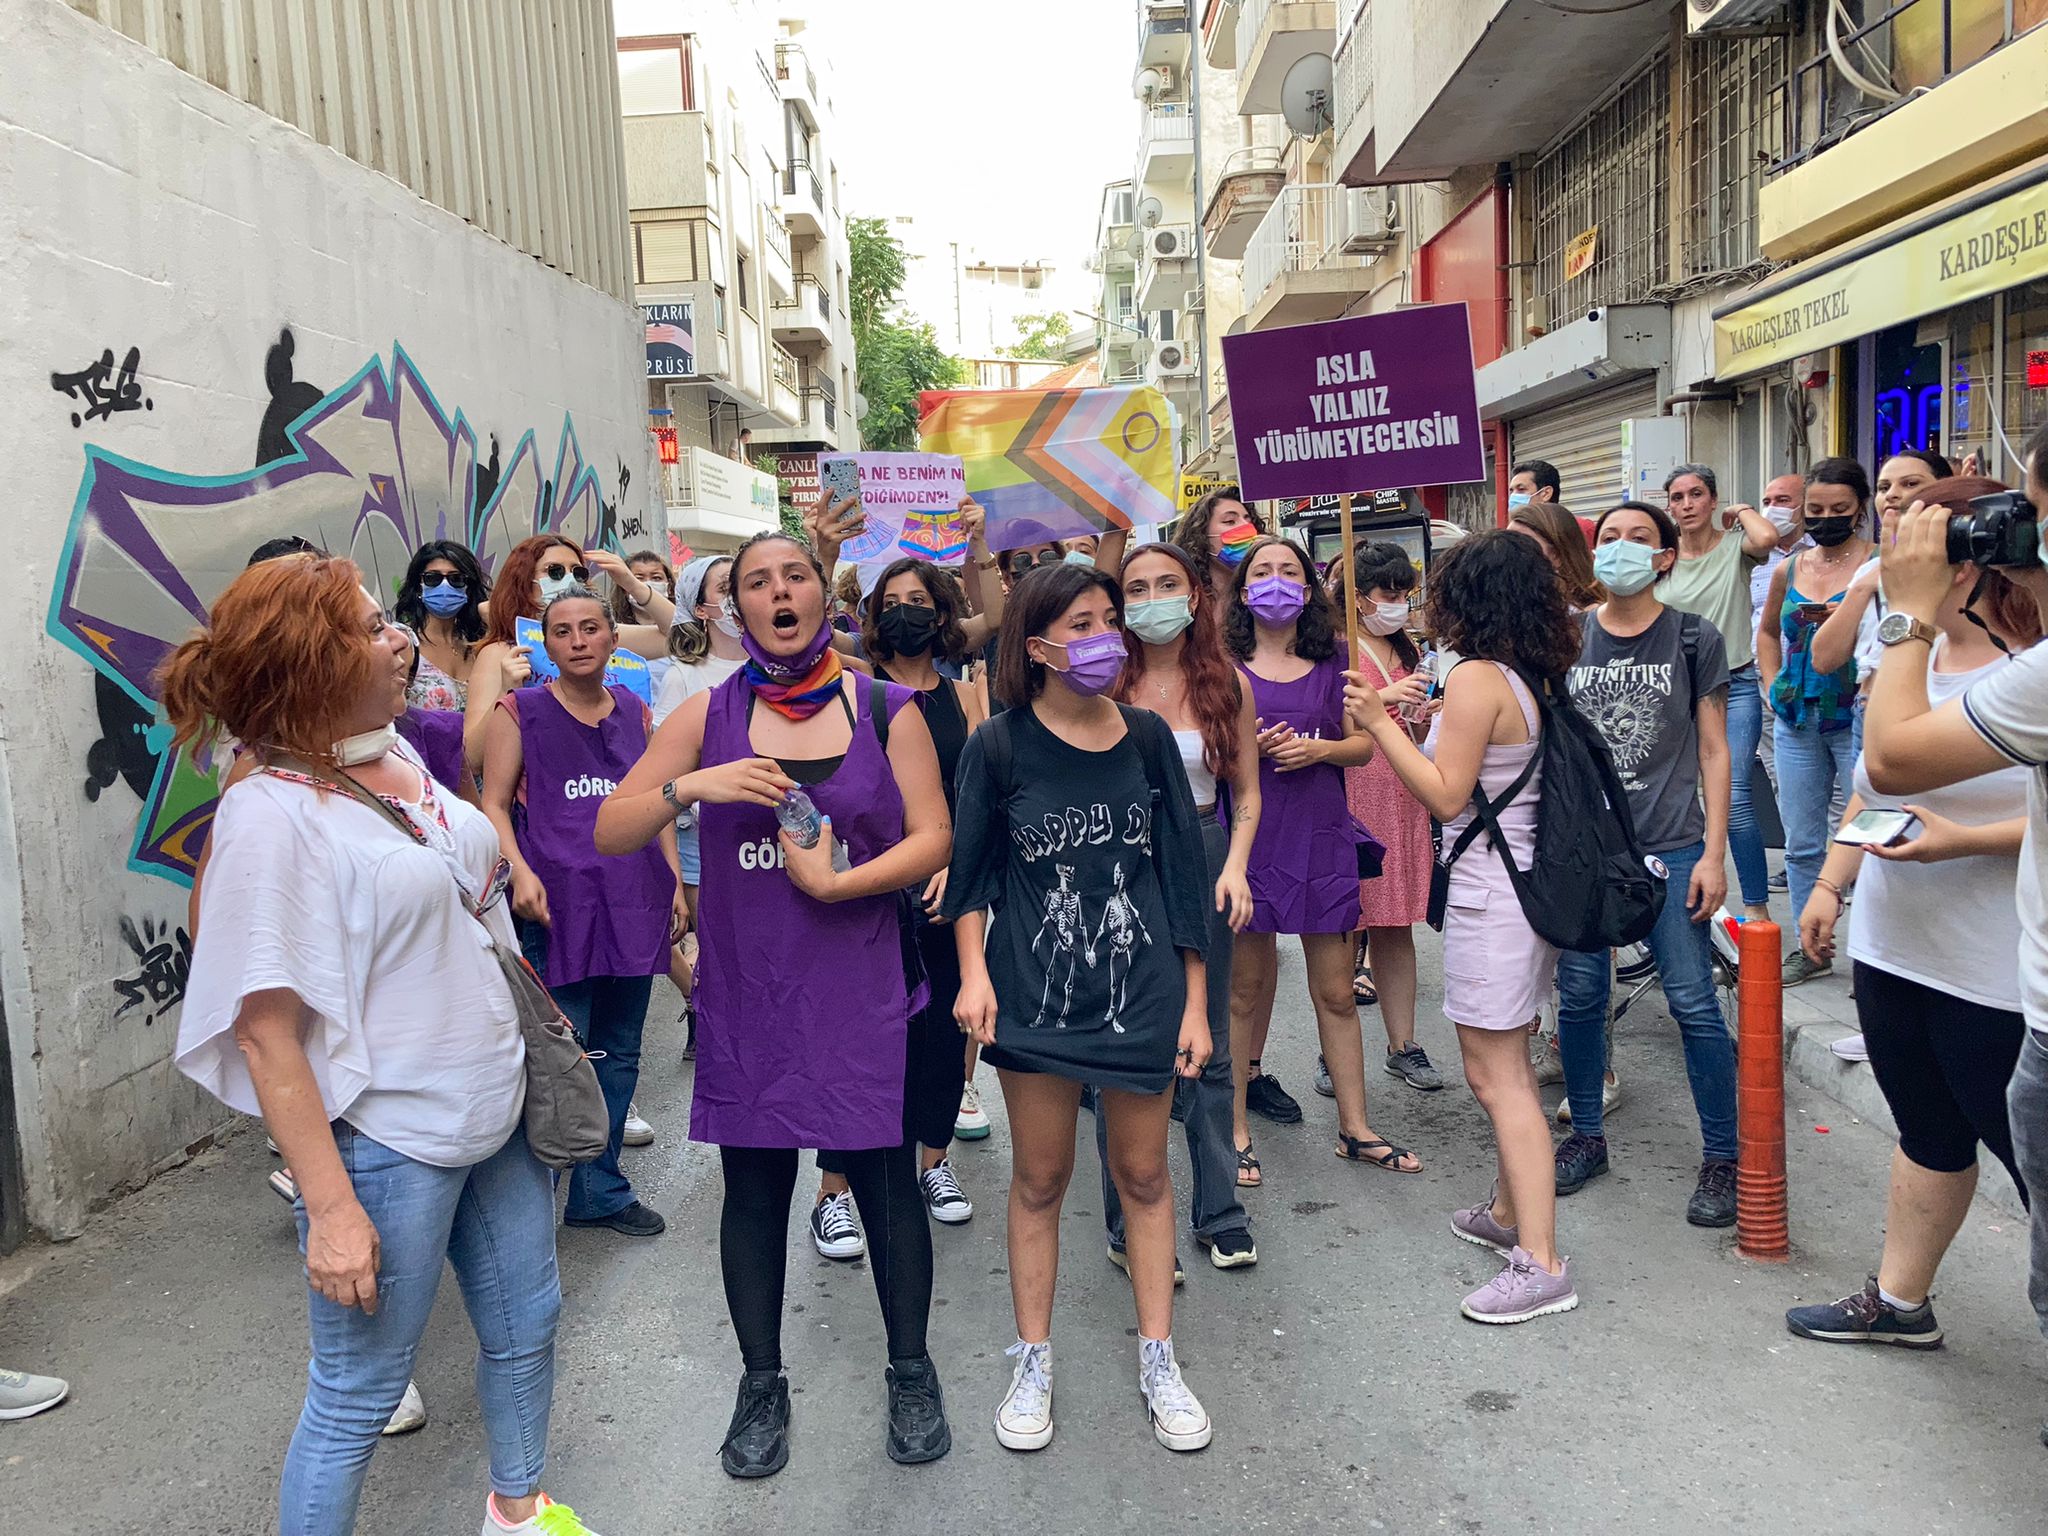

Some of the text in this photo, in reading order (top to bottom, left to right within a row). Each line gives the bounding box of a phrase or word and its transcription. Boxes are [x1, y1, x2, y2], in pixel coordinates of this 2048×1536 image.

[1939, 208, 2048, 282] KARDEŞLE
[643, 305, 692, 321] KLARIN
[1729, 288, 1850, 356] KARDEŞLER TEKEL
[1316, 350, 1376, 387] ASLA
[1309, 385, 1391, 424] YALNIZ
[1253, 411, 1461, 465] YÜRÜMEYECEKSİN
[777, 459, 817, 473] CANLI
[871, 467, 892, 481] NE
[897, 464, 946, 481] BENİM
[951, 467, 965, 482] N
[1375, 489, 1399, 499] CHIPS
[1376, 497, 1400, 505] MASTER
